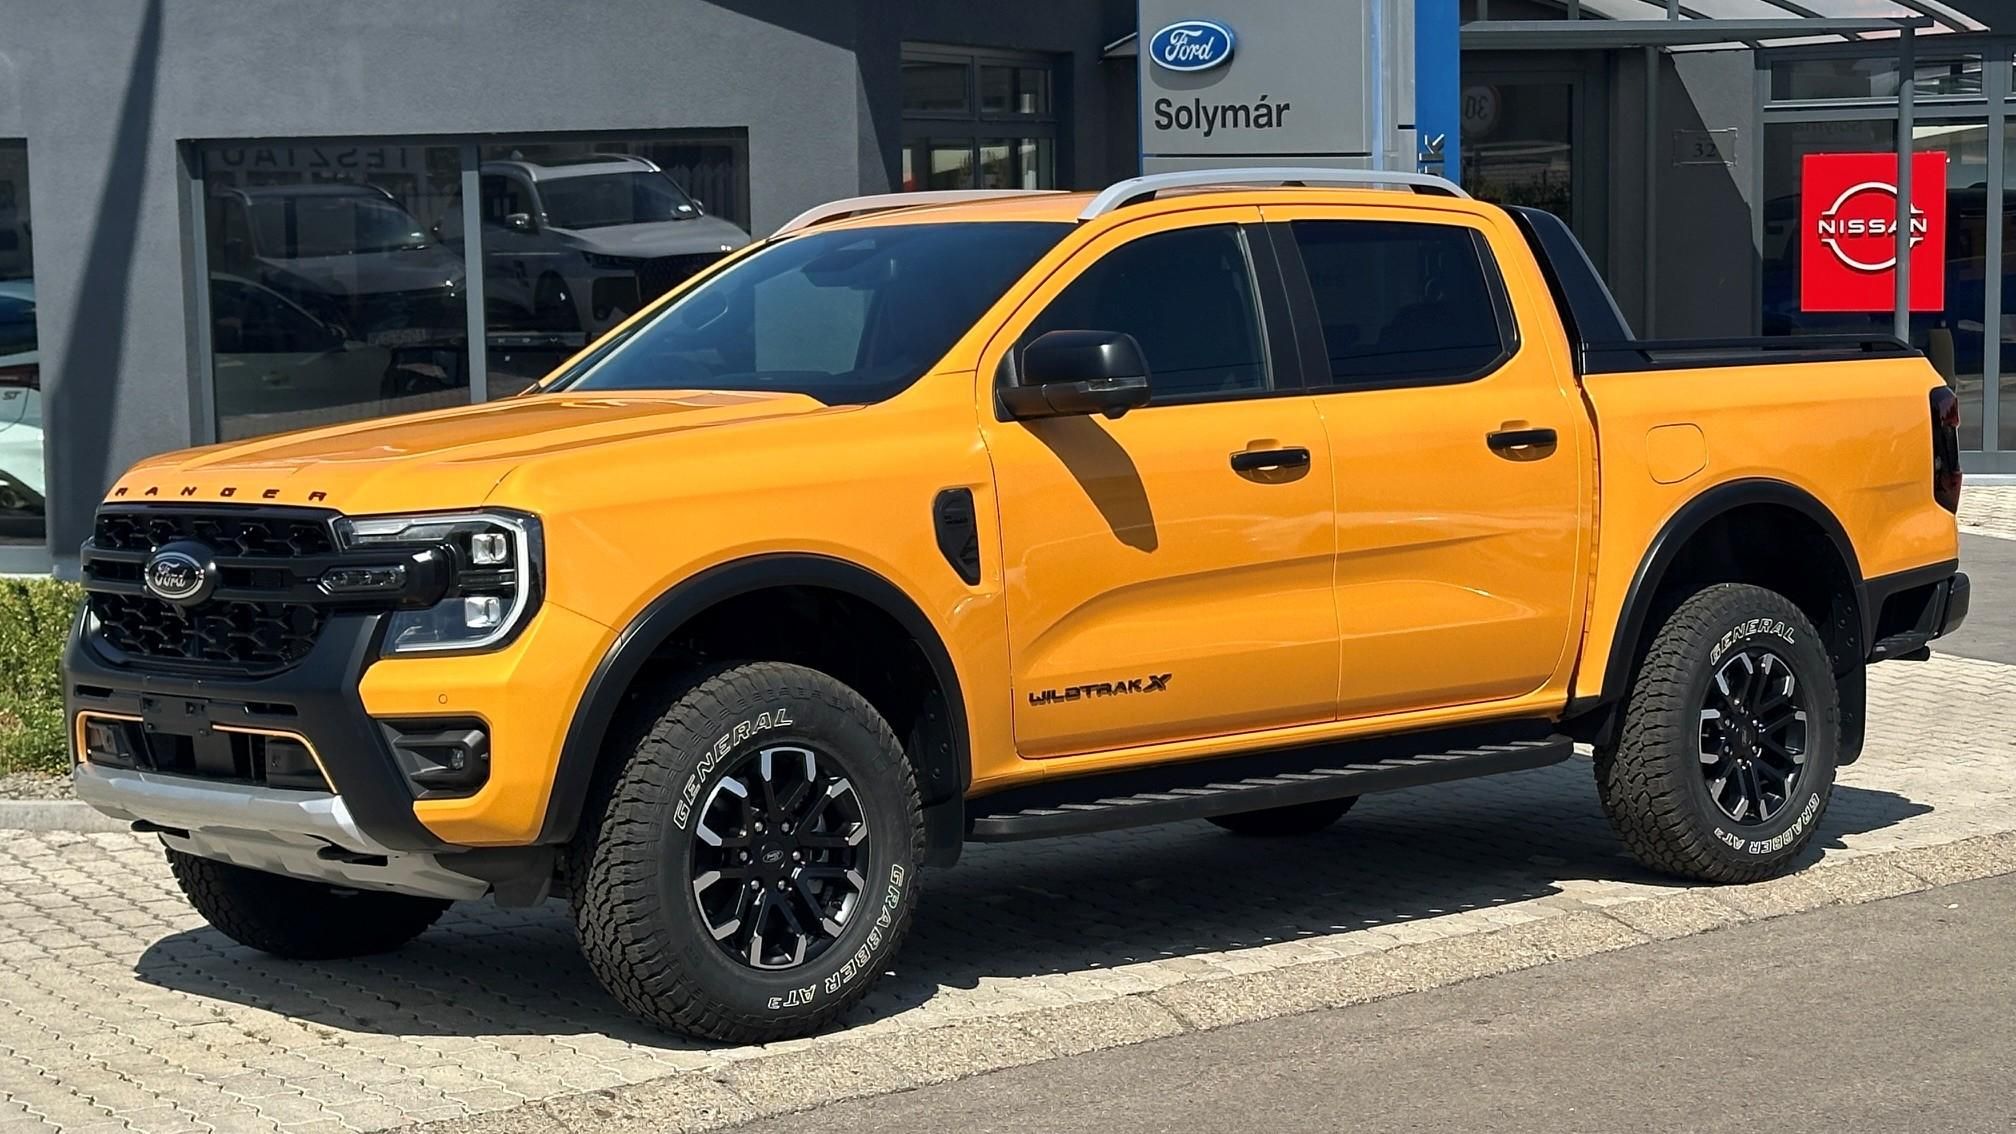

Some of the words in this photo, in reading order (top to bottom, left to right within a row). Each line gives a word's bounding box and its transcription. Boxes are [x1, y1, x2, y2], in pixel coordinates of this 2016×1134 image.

[1165, 29, 1215, 61] Ford
[1154, 95, 1290, 137] Solymár
[1693, 143, 1716, 158] 32
[115, 486, 327, 501] RANGER
[154, 561, 187, 588] Ford
[1710, 618, 1795, 665] GENERAL
[673, 708, 793, 830] GENERAL
[1749, 792, 1820, 854] GRABBER
[825, 864, 905, 994] GRABBER
